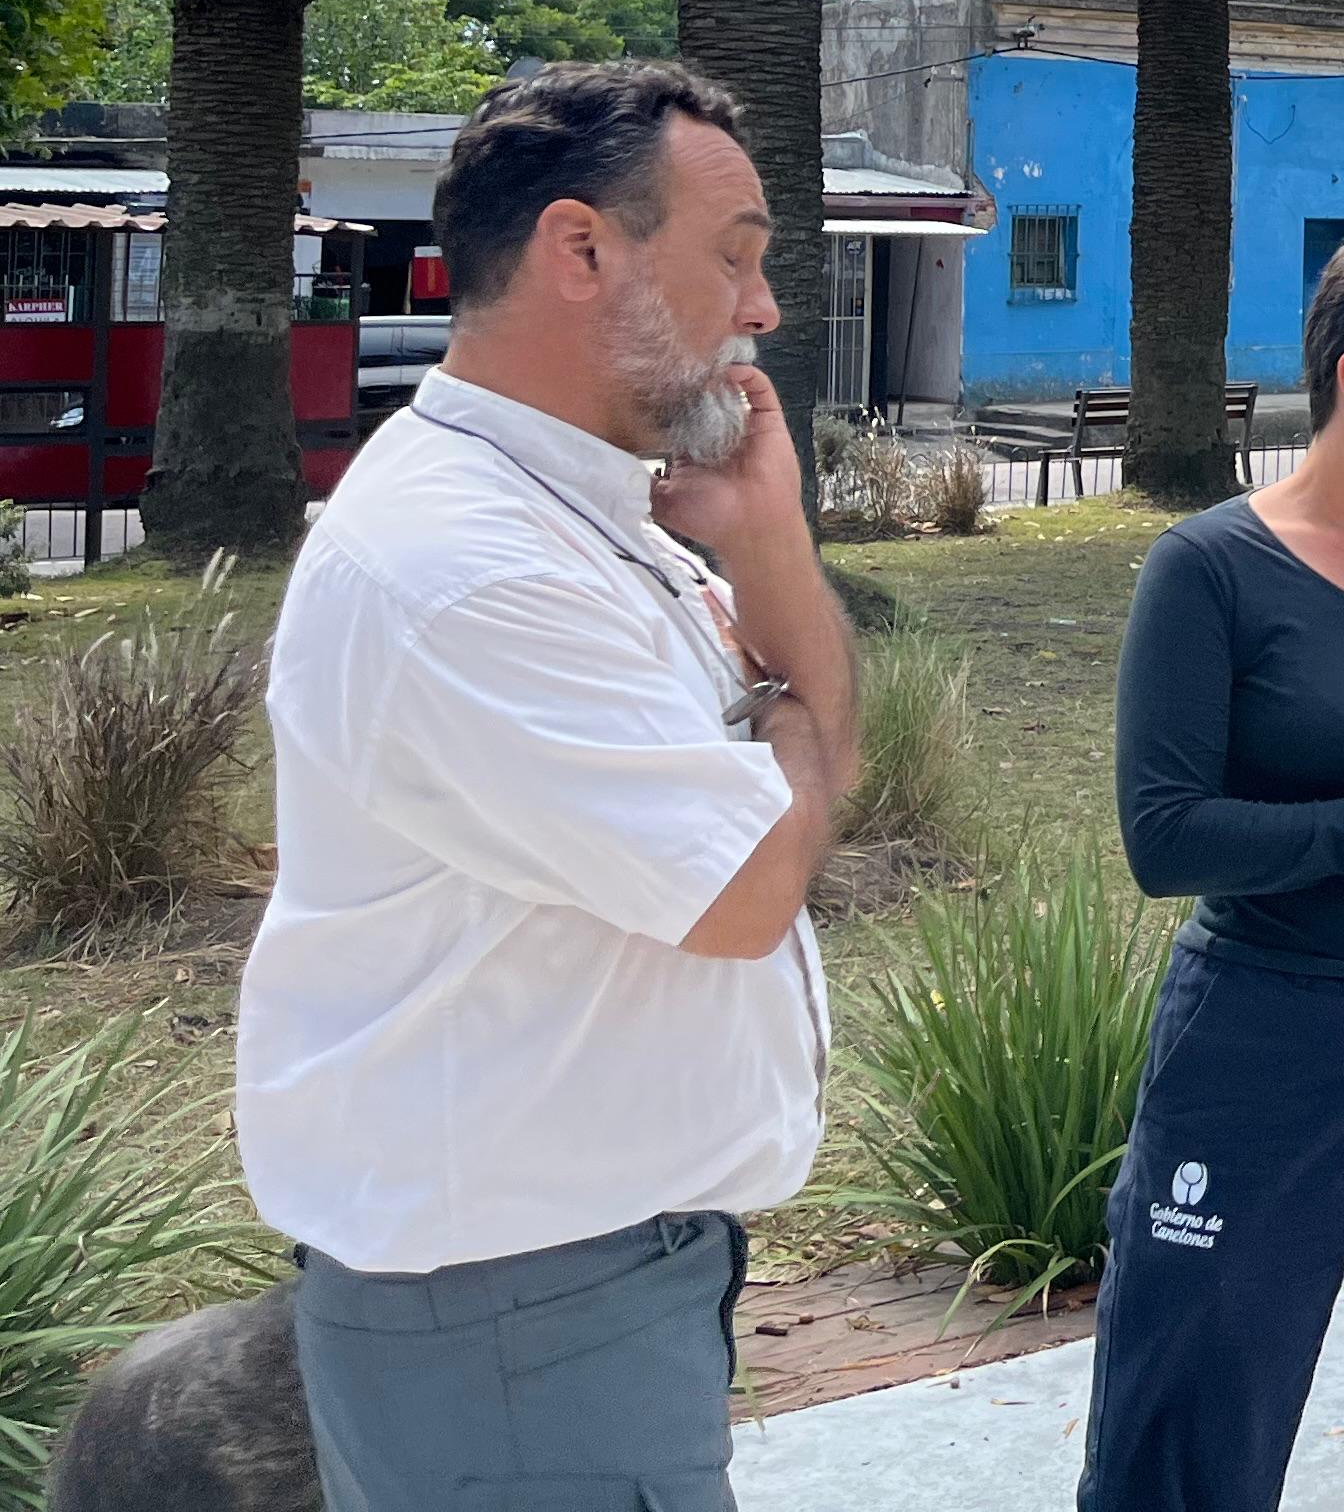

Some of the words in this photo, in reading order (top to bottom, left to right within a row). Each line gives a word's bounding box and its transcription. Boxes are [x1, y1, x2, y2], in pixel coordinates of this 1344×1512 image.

[1150, 1202, 1204, 1229] Gobierno
[1204, 1214, 1224, 1232] de
[1151, 1220, 1216, 1249] Canelones
